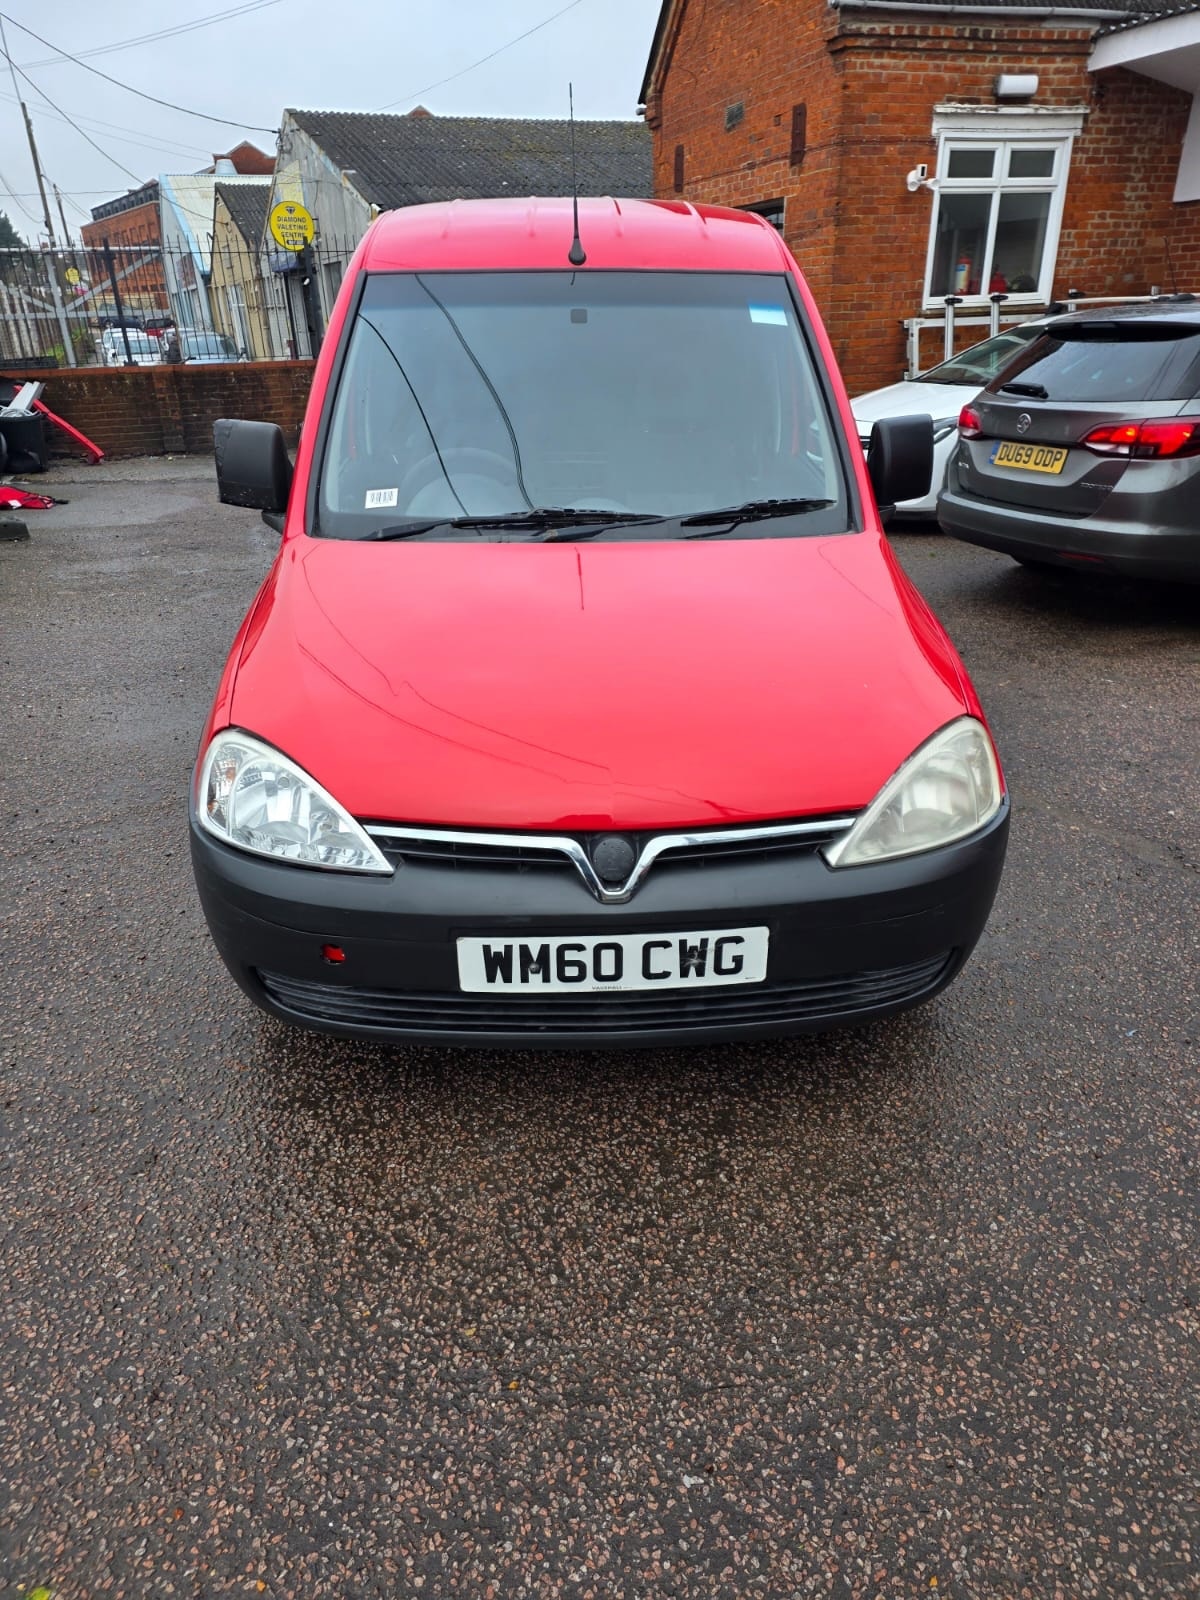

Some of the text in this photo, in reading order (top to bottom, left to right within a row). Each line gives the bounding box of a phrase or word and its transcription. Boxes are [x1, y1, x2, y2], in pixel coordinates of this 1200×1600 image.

[998, 443, 1063, 468] DU69 ODP
[482, 935, 745, 983] WM60 CWG
